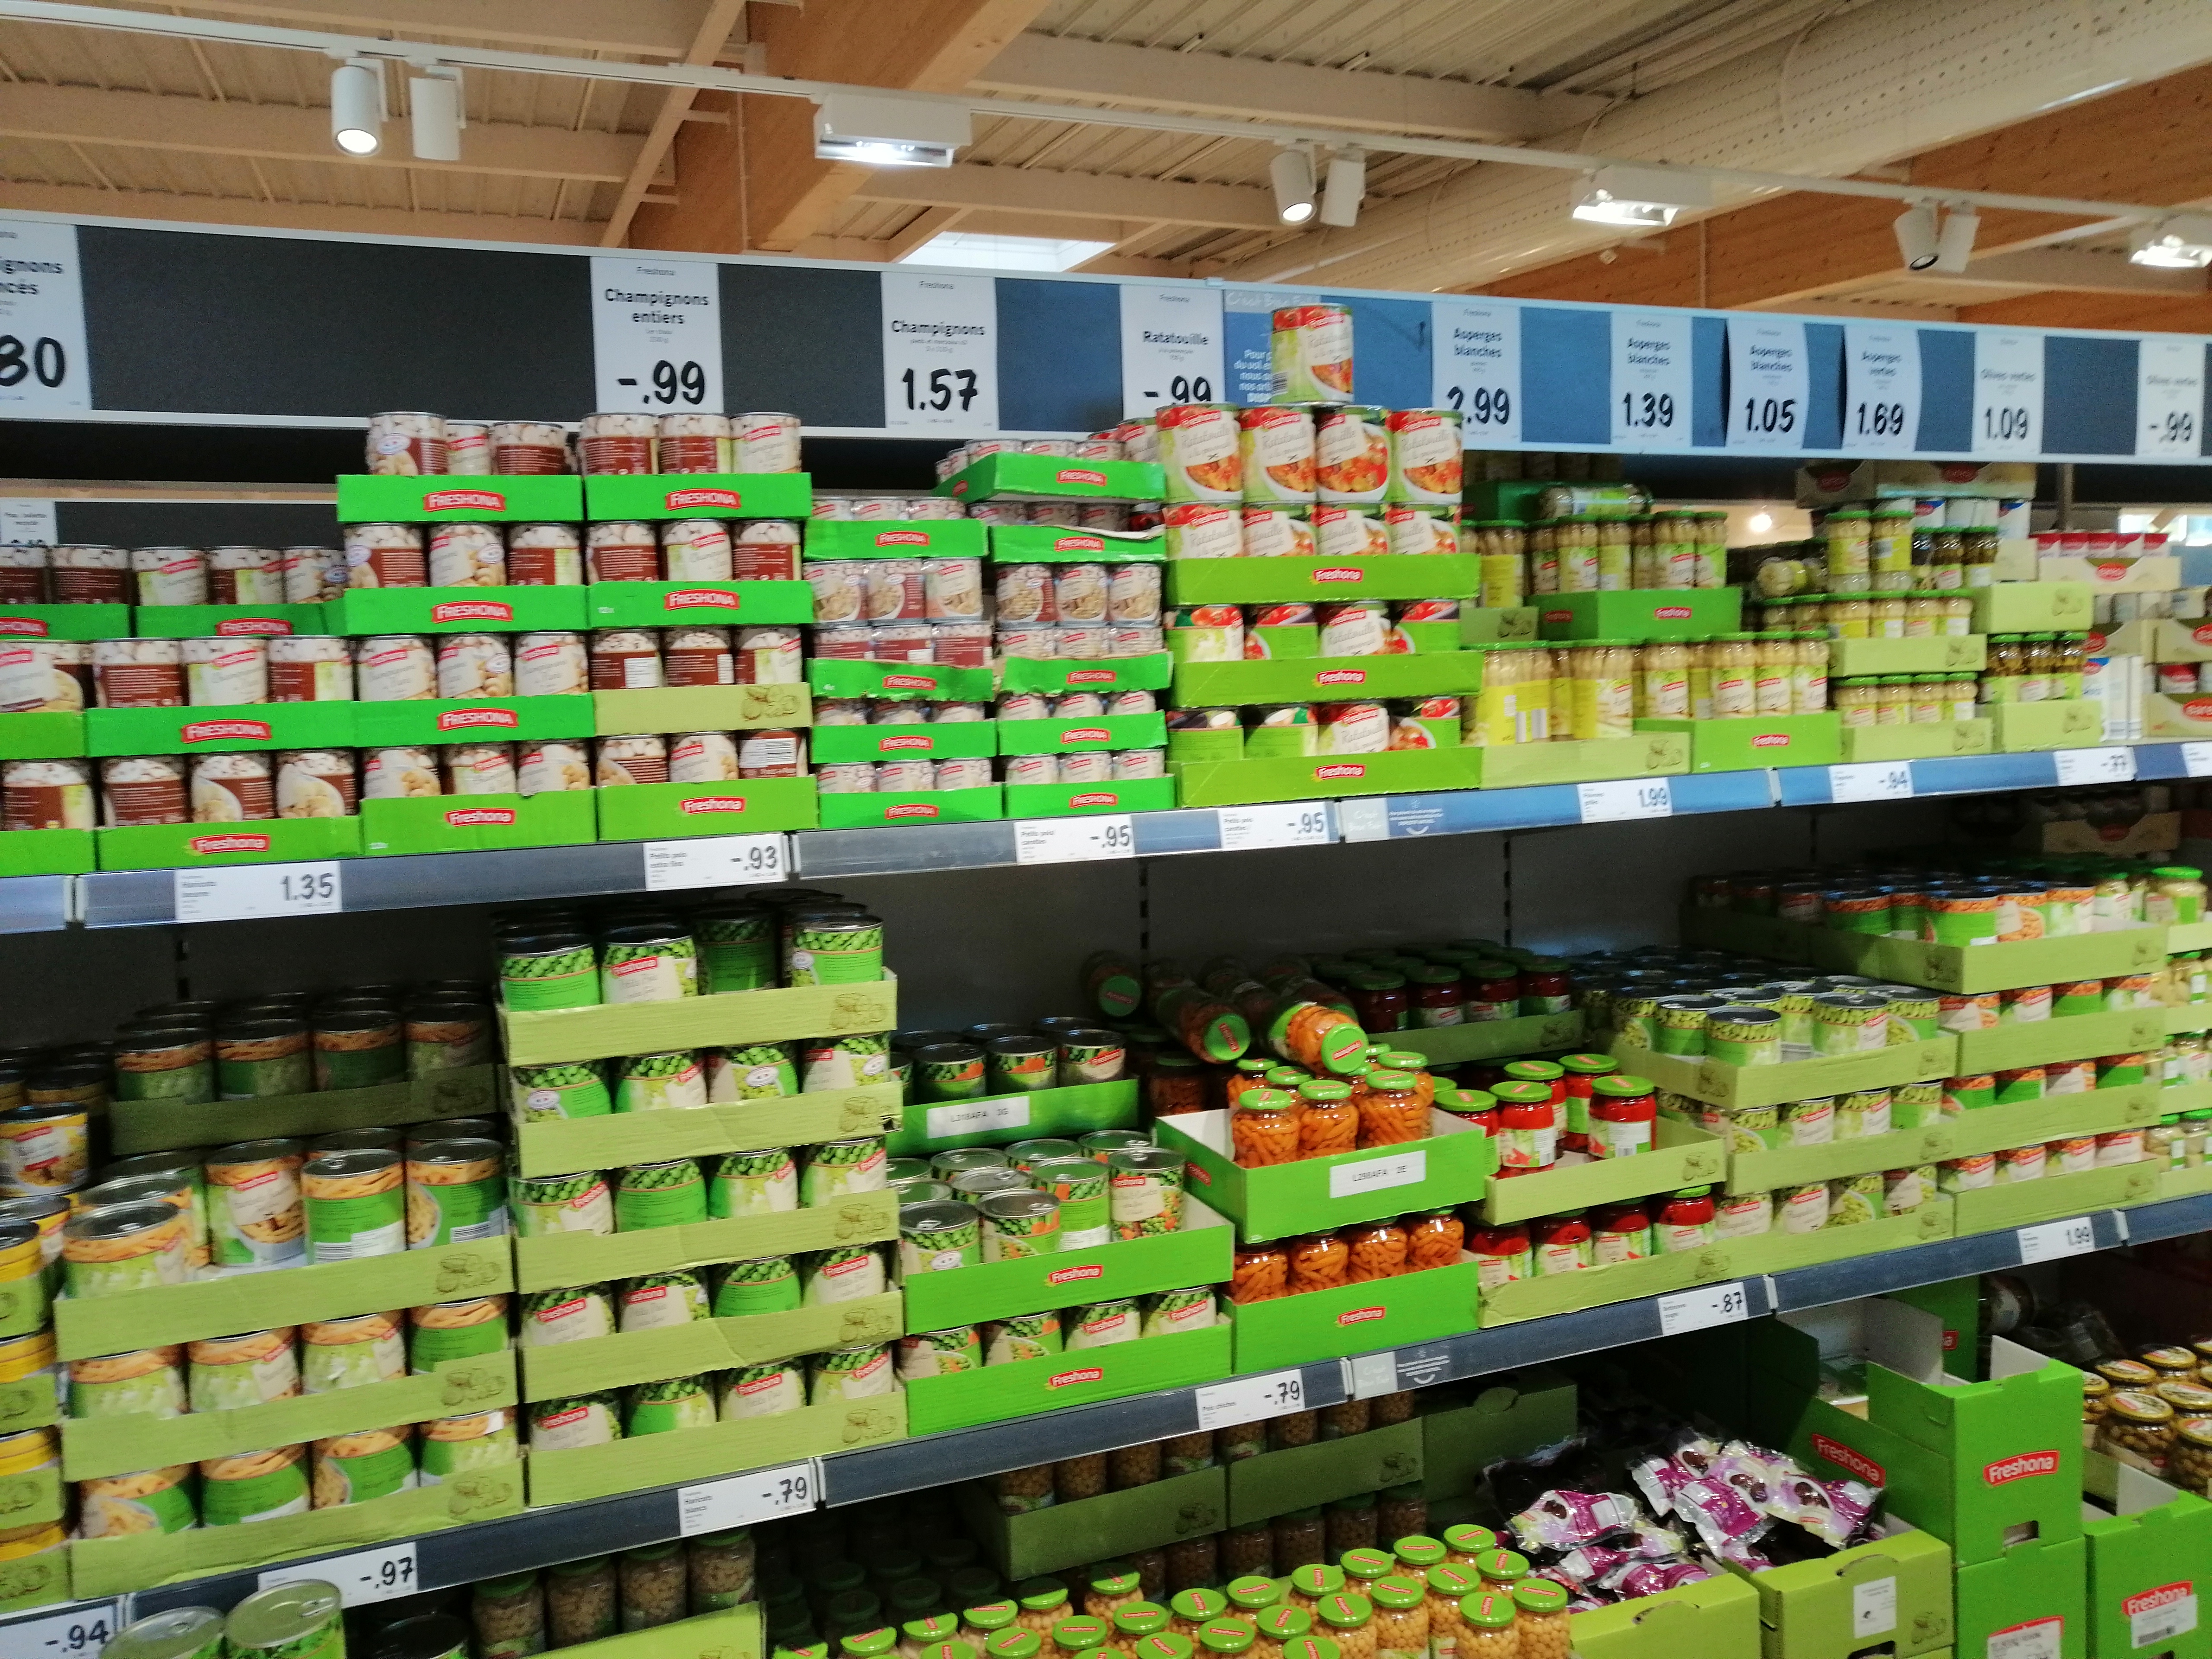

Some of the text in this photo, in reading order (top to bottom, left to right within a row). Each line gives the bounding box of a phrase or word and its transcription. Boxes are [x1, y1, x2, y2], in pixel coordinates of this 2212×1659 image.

[605, 288, 709, 307] Champignons
[632, 309, 685, 324] entiers
[891, 319, 986, 337] Champignons
[1454, 327, 1503, 342] Asperges
[1143, 330, 1208, 346] Ratatouille
[1627, 337, 1671, 352] Asperges
[1454, 345, 1502, 358] blanches
[1627, 354, 1671, 366] blanches
[617, 360, 706, 405] -.99
[903, 368, 980, 413] 1.57
[1446, 386, 1510, 425] 2.99
[1621, 392, 1674, 428] 1.39
[1745, 397, 1797, 433] 1.05
[1857, 401, 1904, 435] 1.69
[1984, 407, 2029, 441] 1.09
[2148, 411, 2192, 444] -.99
[430, 494, 499, 507] FRESHONA
[671, 492, 735, 505] FRESHONA
[1316, 570, 1359, 579] Freshona
[670, 593, 734, 606] FRESHONA
[438, 605, 506, 619] FRESHONA
[1320, 672, 1362, 682] Freshona
[444, 712, 512, 726] FRESHONA
[189, 724, 264, 739] FRESHONA
[1319, 766, 1361, 776] Freshona
[685, 799, 740, 810] Freshona
[1637, 786, 1667, 808] 1.99
[451, 811, 509, 823] Freshona
[1287, 812, 1325, 835] -.95
[197, 837, 264, 849] Freshona
[1090, 824, 1131, 849] -.95
[731, 844, 778, 871] -.93
[278, 871, 335, 901] 1.35
[2066, 1226, 2090, 1247] 1.99
[1052, 1268, 1098, 1280] Freshona
[1170, 1302, 1205, 1318] Freshona
[1710, 1290, 1743, 1314] -.87
[1085, 1316, 1122, 1332] Freshona
[1341, 1309, 1382, 1322] Freshona
[1053, 1371, 1098, 1383] Freshona
[1264, 1380, 1300, 1406] -.79
[1817, 1438, 1880, 1482] Freshona
[1988, 1454, 2054, 1484] Freshona
[761, 1476, 807, 1506] -.79
[360, 1556, 413, 1589] -.97
[44, 1620, 108, 1653] -.94
